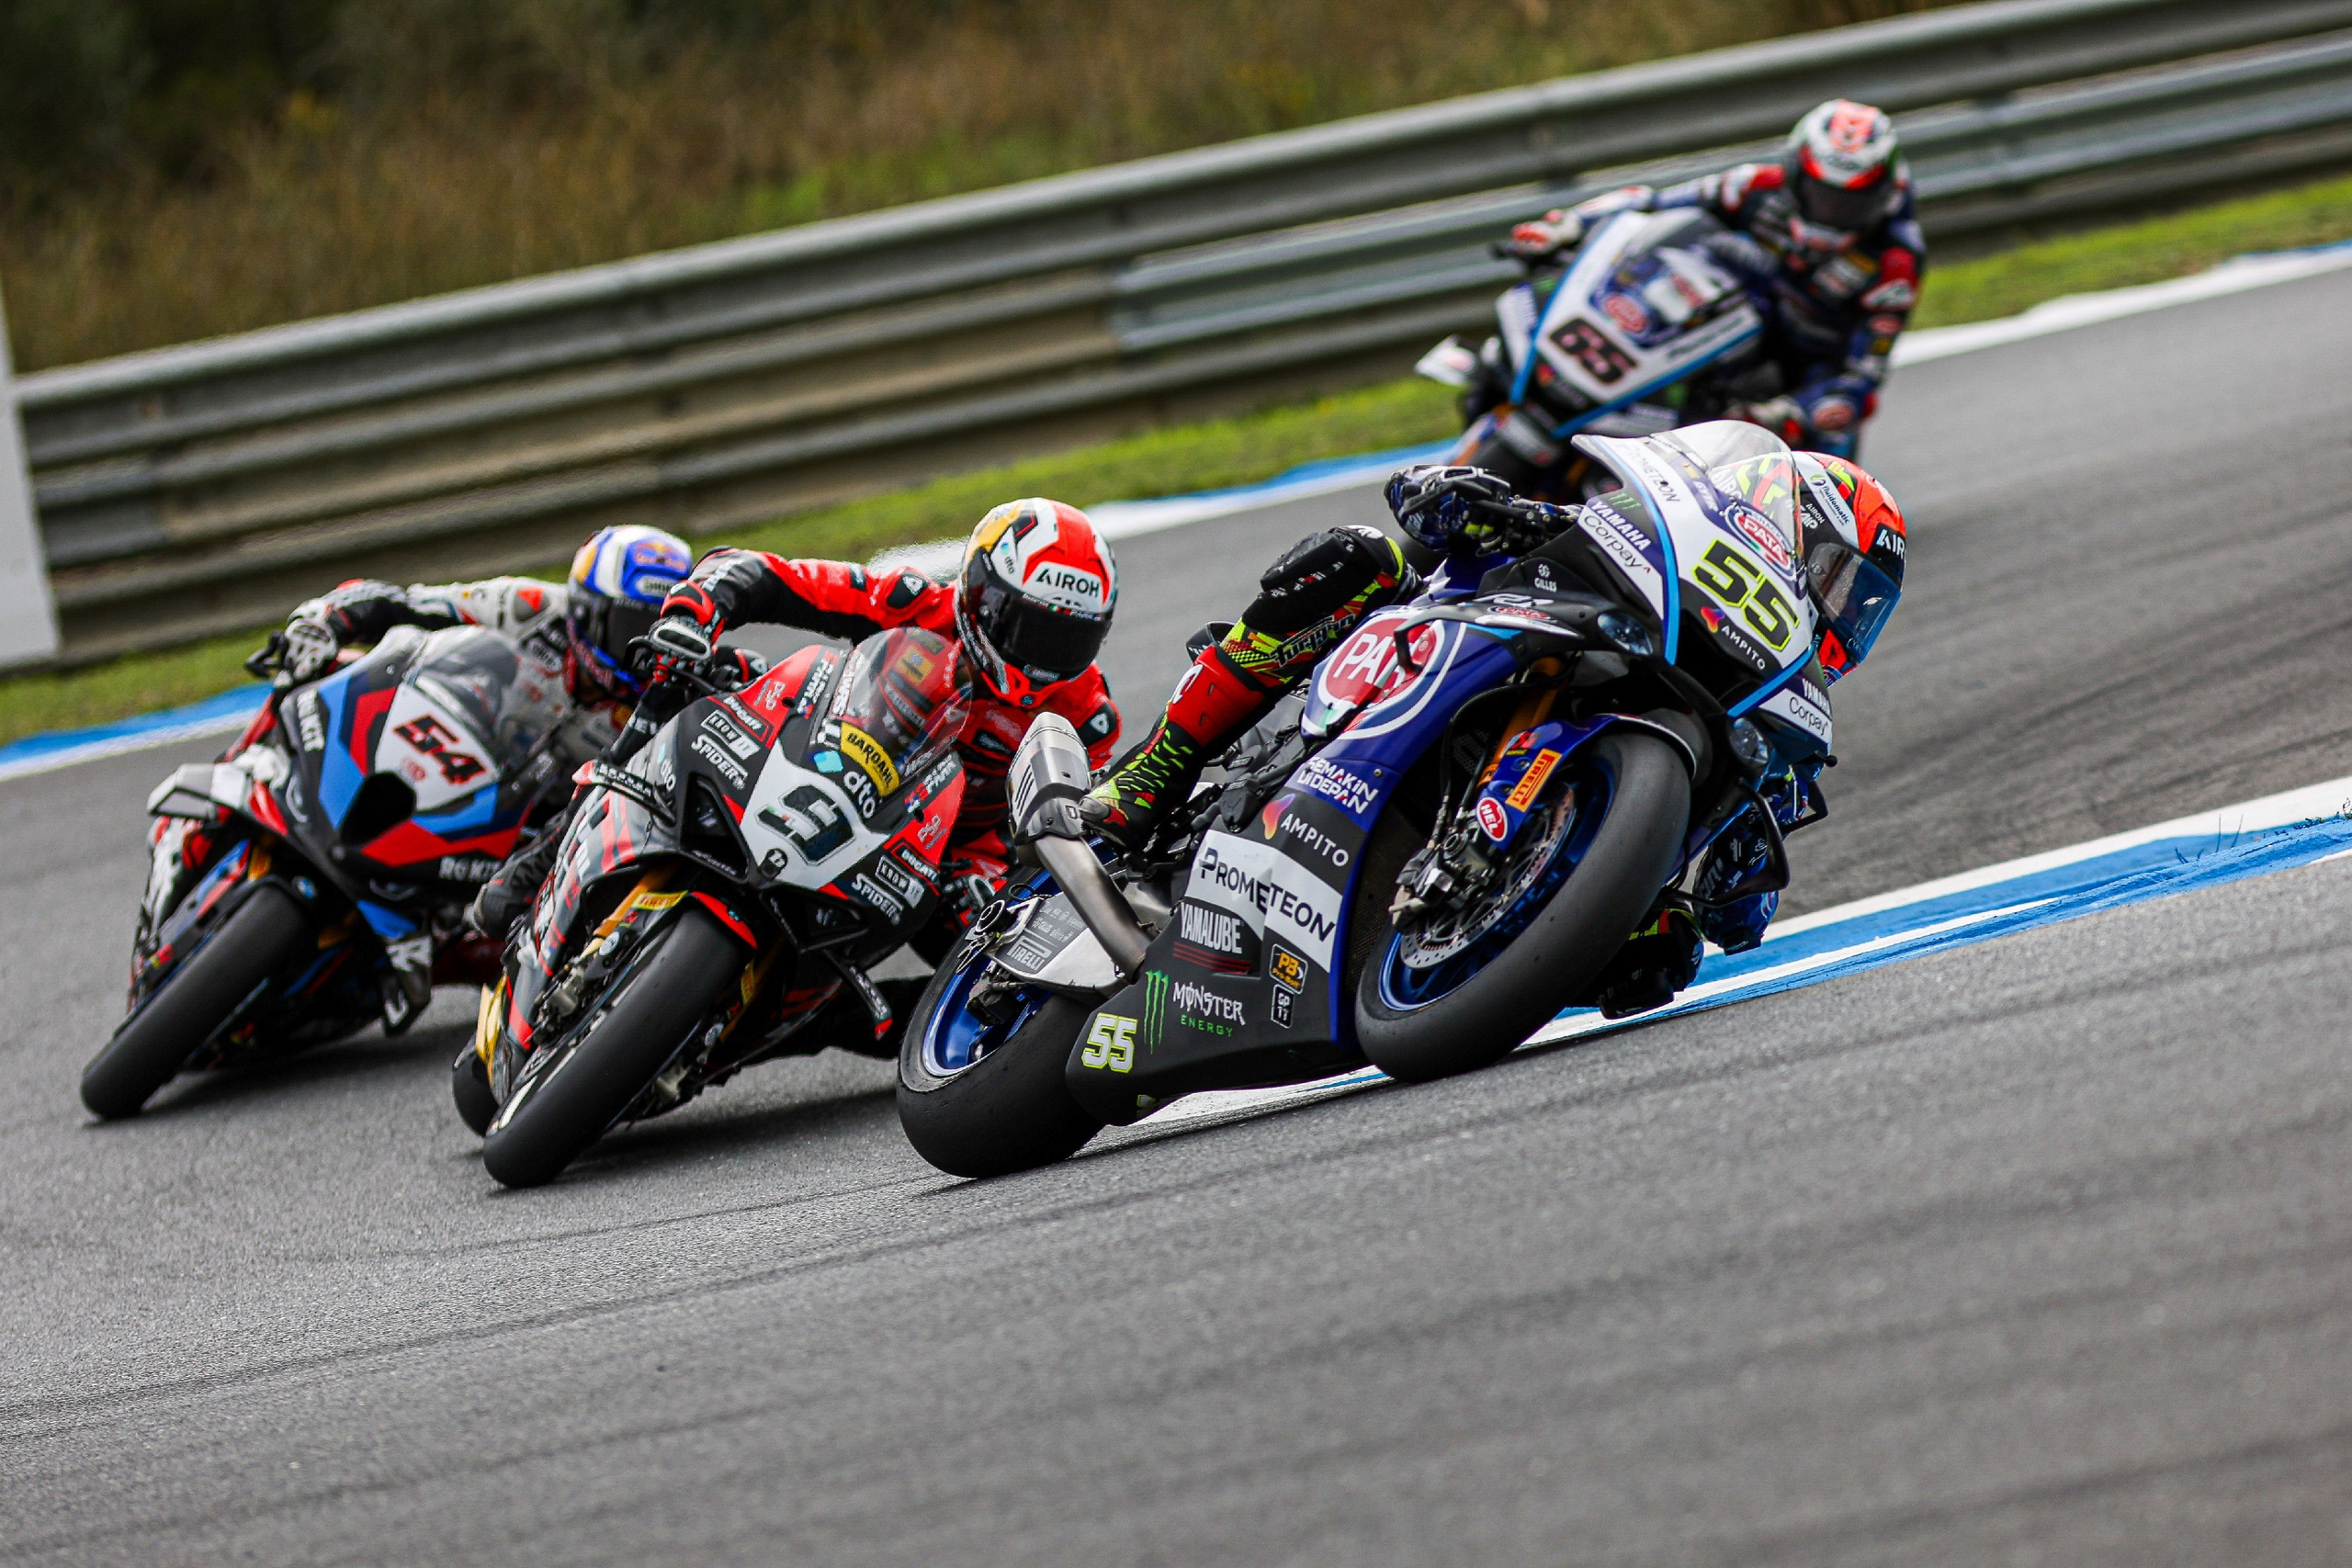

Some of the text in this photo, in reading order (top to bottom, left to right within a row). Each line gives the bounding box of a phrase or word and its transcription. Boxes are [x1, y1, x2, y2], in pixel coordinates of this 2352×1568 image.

[1584, 516, 1643, 570] Corpay
[1590, 501, 1652, 551] YAMAHA
[1744, 516, 1785, 563] PATA
[1035, 568, 1100, 599] AIROH
[1692, 539, 1799, 650] 55
[1721, 625, 1766, 671] AMPITO
[709, 714, 738, 740] KNOW
[722, 695, 763, 731] DUCATI
[1789, 695, 1827, 736] Corpay
[392, 714, 486, 785] 54
[691, 733, 749, 782] SPIDER
[846, 732, 895, 786] BARDAHL
[843, 771, 876, 818] dto
[1512, 752, 1555, 807] PIRELLI
[1281, 813, 1350, 868] AMPITO
[1480, 803, 1499, 833] HEL
[880, 862, 909, 891] KNOW
[900, 849, 938, 883] DUCATI
[851, 873, 906, 919] SPIDER
[1198, 846, 1337, 942] PROMETEON
[1181, 902, 1242, 953] YAMALUBE
[1006, 935, 1053, 971] PIRELLI
[1277, 951, 1298, 976] PB
[1172, 982, 1247, 1025] MONSTER
[1181, 1015, 1234, 1037] ENERGY
[1081, 1012, 1139, 1074] 55
